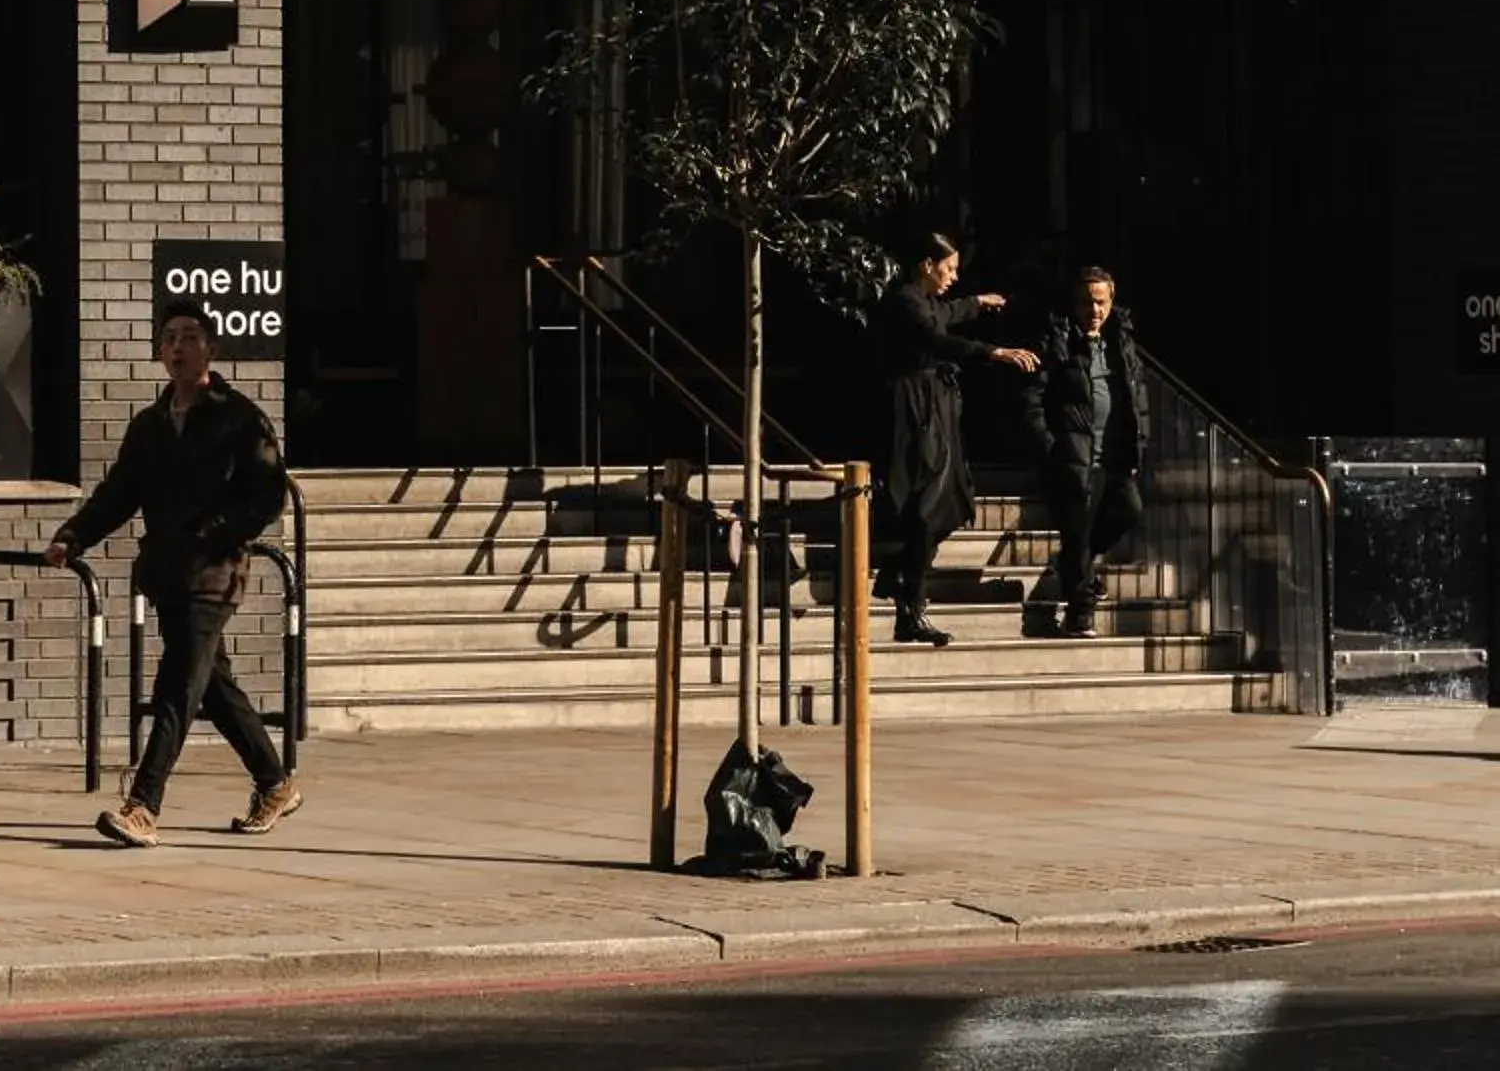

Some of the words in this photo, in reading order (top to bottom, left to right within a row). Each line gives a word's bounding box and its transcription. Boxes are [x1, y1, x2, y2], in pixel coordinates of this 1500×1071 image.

[165, 267, 231, 294] one
[241, 260, 283, 295] hu
[203, 300, 282, 336] hore
